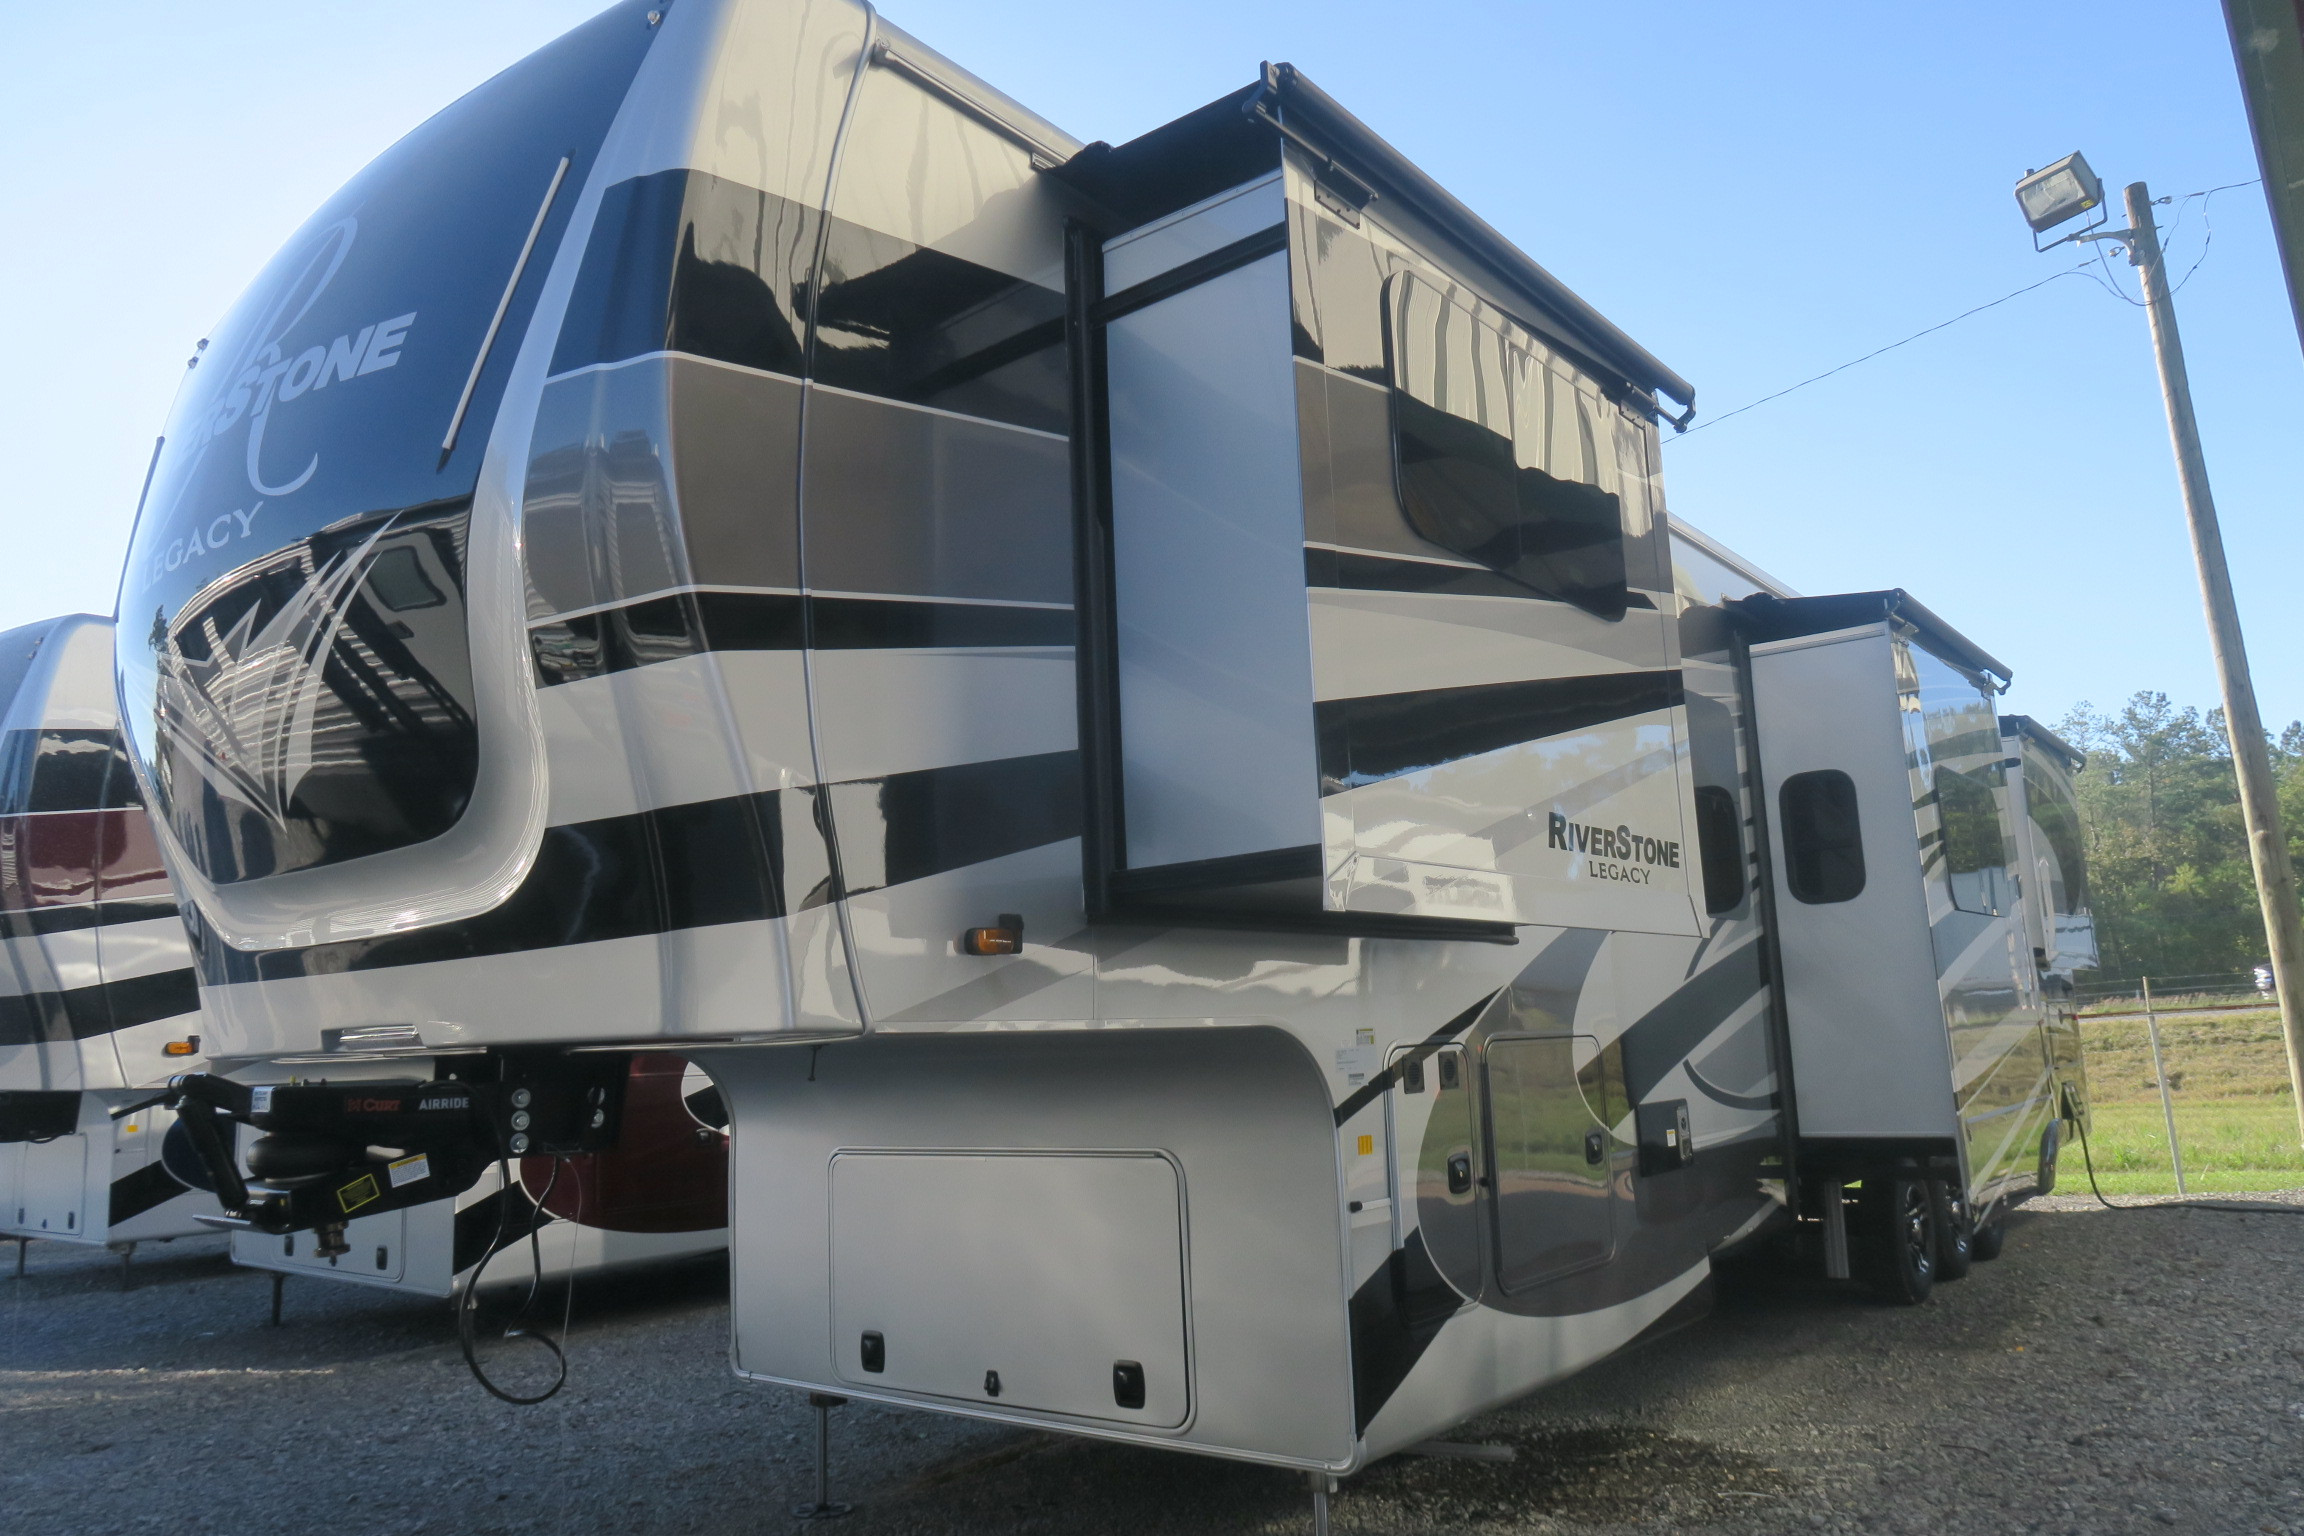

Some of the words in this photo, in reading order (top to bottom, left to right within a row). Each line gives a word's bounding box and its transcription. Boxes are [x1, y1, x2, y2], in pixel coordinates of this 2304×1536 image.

[142, 500, 264, 595] LEGACY
[1548, 811, 1680, 869] RIVERSTONE
[1588, 860, 1651, 885] LEGACY
[362, 1097, 401, 1112] CURT
[418, 1097, 470, 1111] AIRRIDE
